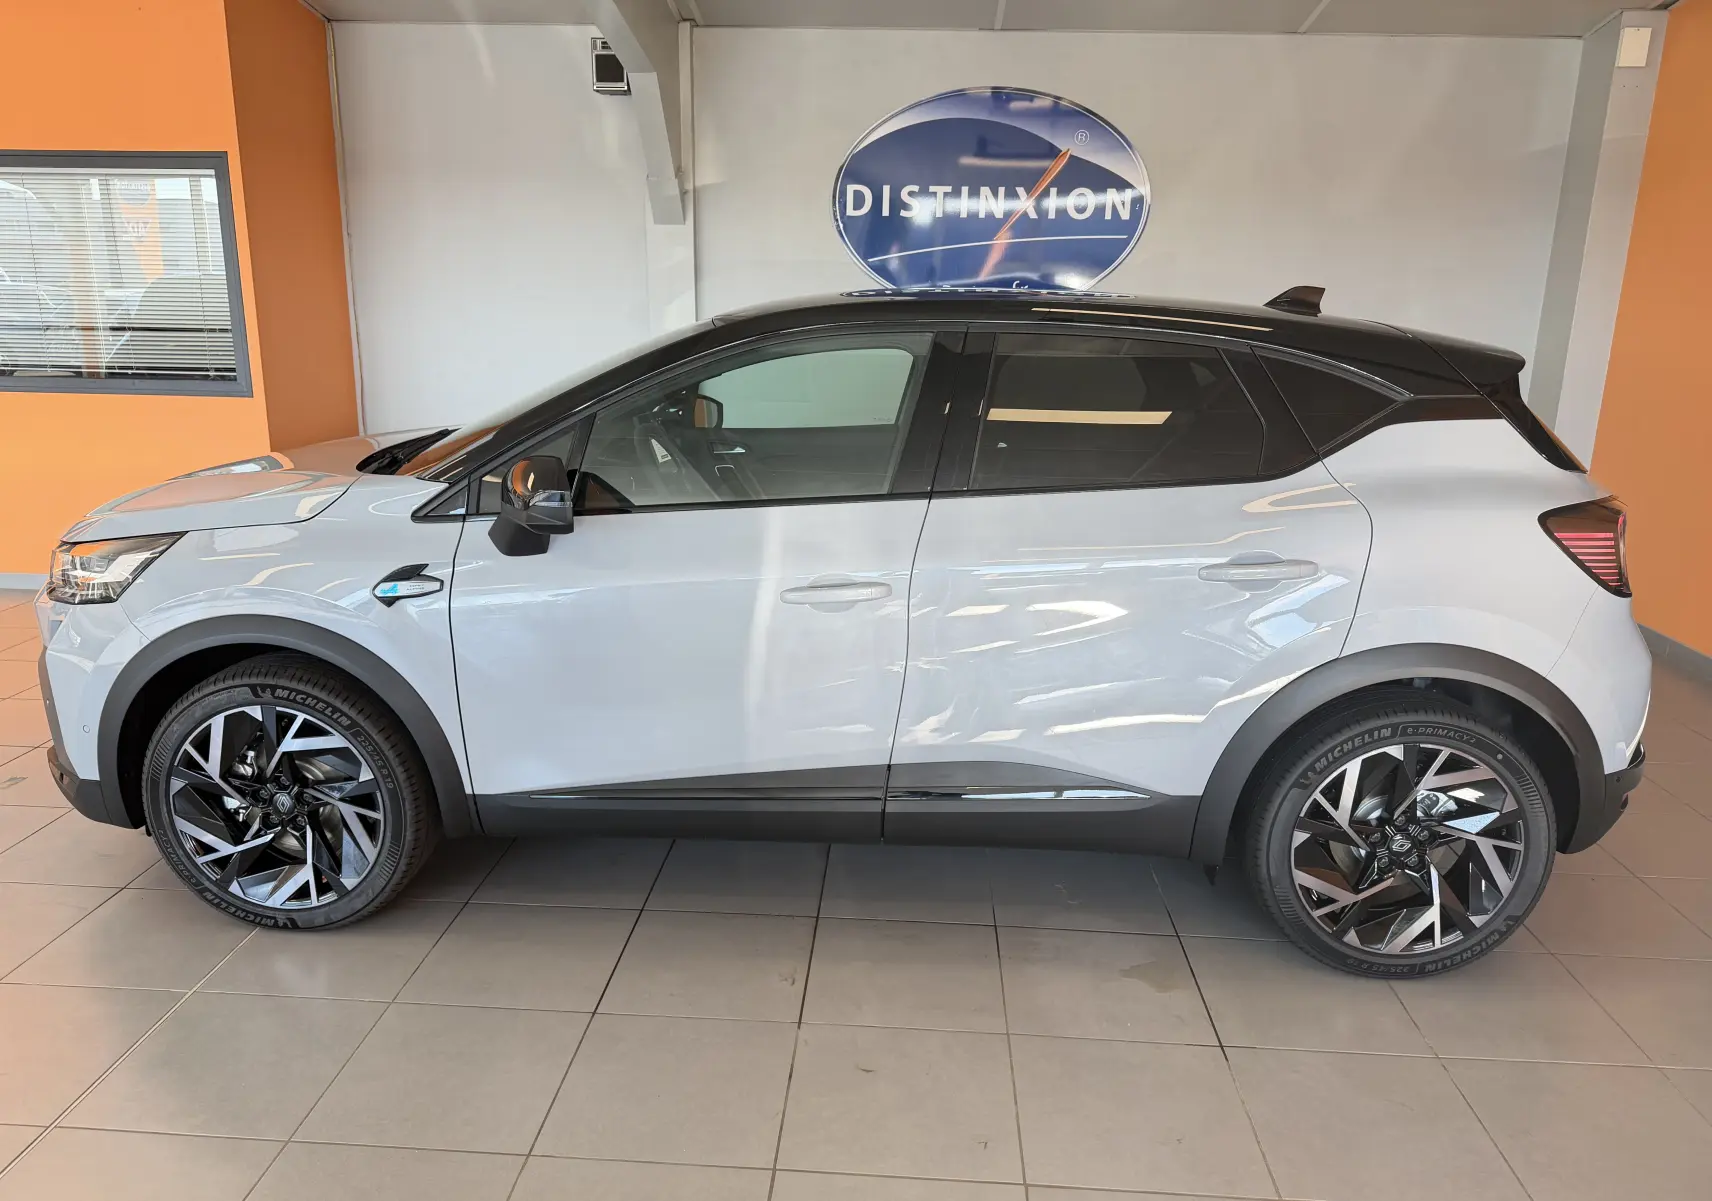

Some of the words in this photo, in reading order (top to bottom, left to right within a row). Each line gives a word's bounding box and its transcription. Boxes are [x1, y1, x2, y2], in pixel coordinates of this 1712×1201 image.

[845, 184, 1132, 221] DISTINXION
[274, 688, 352, 727] MICHELIN
[357, 736, 385, 767] 225/45
[380, 768, 388, 776] R
[1314, 727, 1392, 773] MICHELIN
[202, 890, 275, 927] MICHELIN
[1424, 931, 1500, 973] MICHELIN
